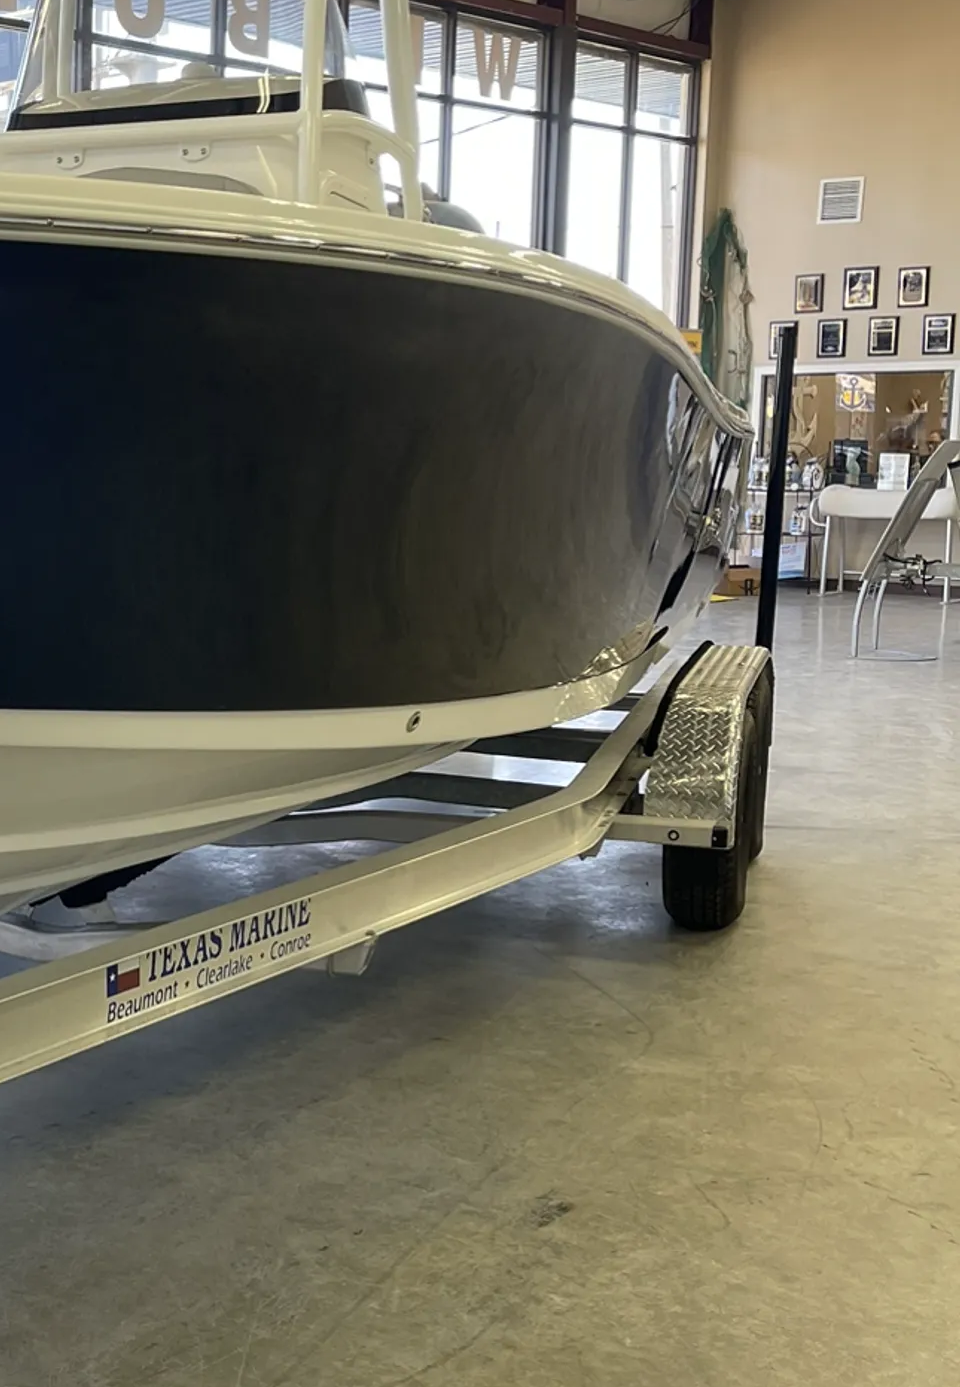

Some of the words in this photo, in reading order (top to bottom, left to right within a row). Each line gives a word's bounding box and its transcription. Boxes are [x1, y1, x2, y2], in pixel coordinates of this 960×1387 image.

[107, 980, 179, 1024] Beaumont
[196, 952, 253, 989] Clearlake
[269, 932, 312, 960] Conroe
[146, 927, 223, 983] TEXAS
[228, 897, 312, 953] MARINE
